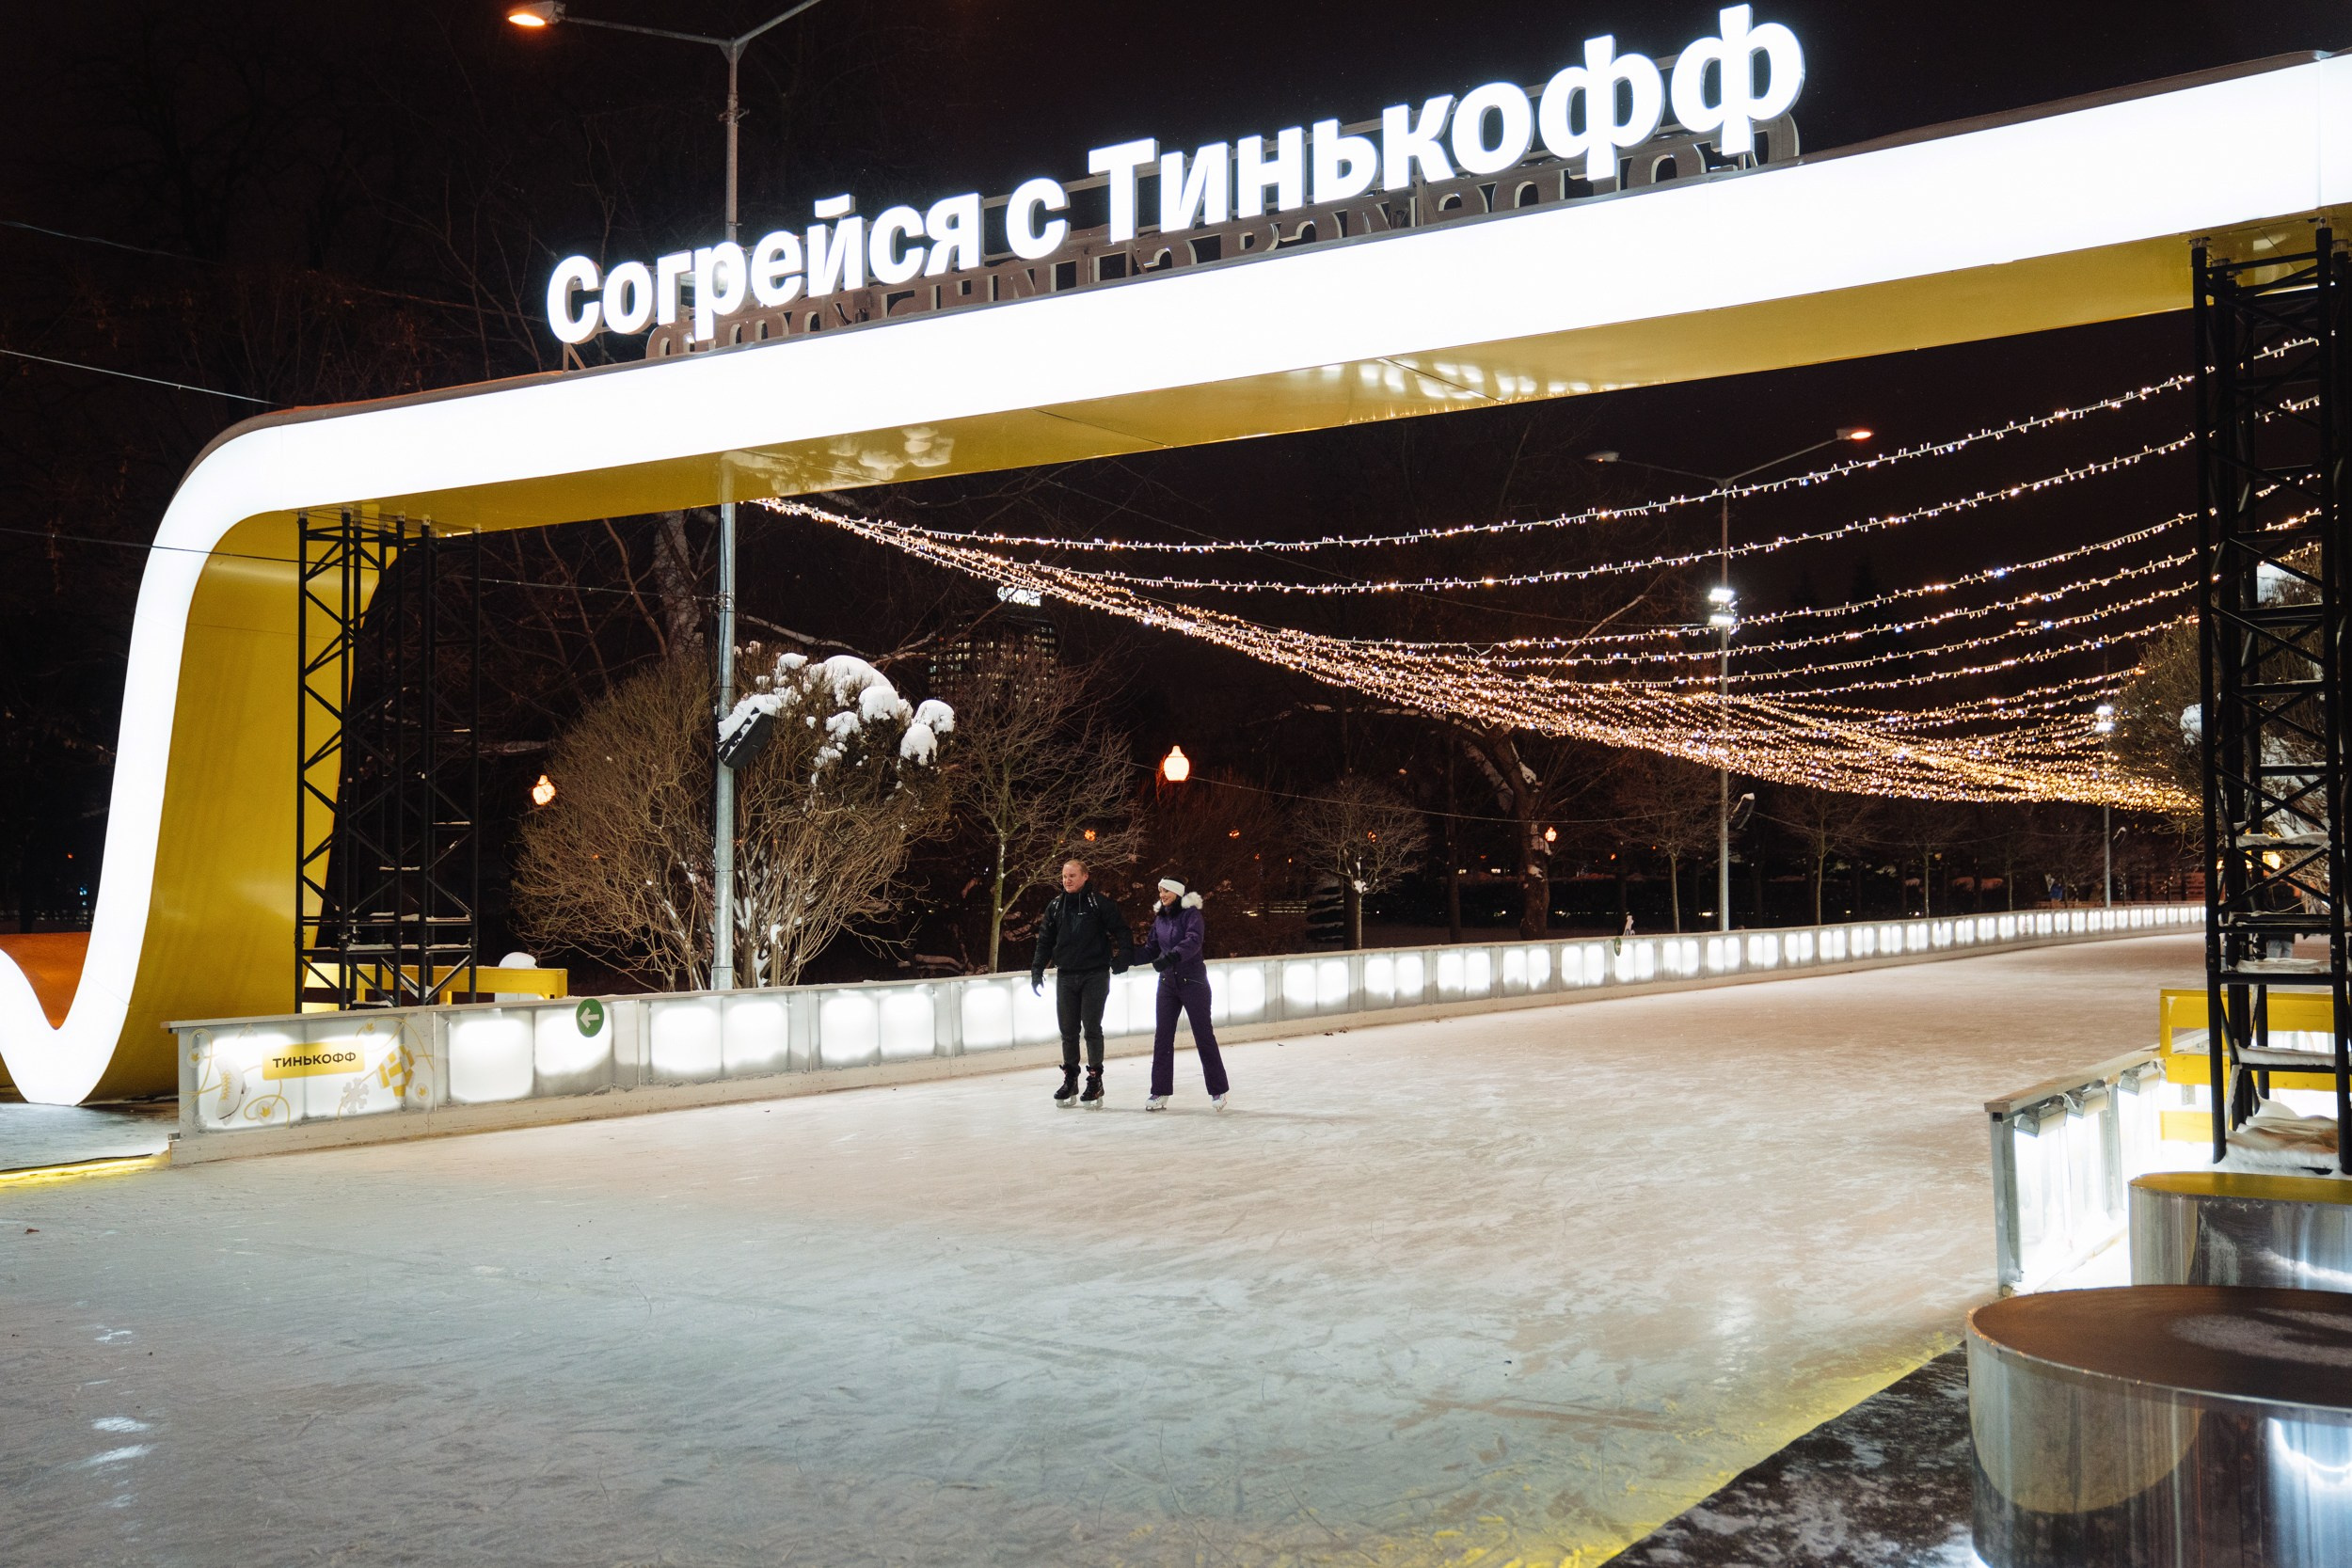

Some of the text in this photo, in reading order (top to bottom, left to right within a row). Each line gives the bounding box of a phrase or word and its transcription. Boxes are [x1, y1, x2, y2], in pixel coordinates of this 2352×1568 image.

[548, 192, 984, 343] Согрейся
[1007, 179, 1070, 260] с
[1089, 4, 1804, 243] Тинькофф
[272, 1052, 357, 1069] ТИНЬКОФФ
